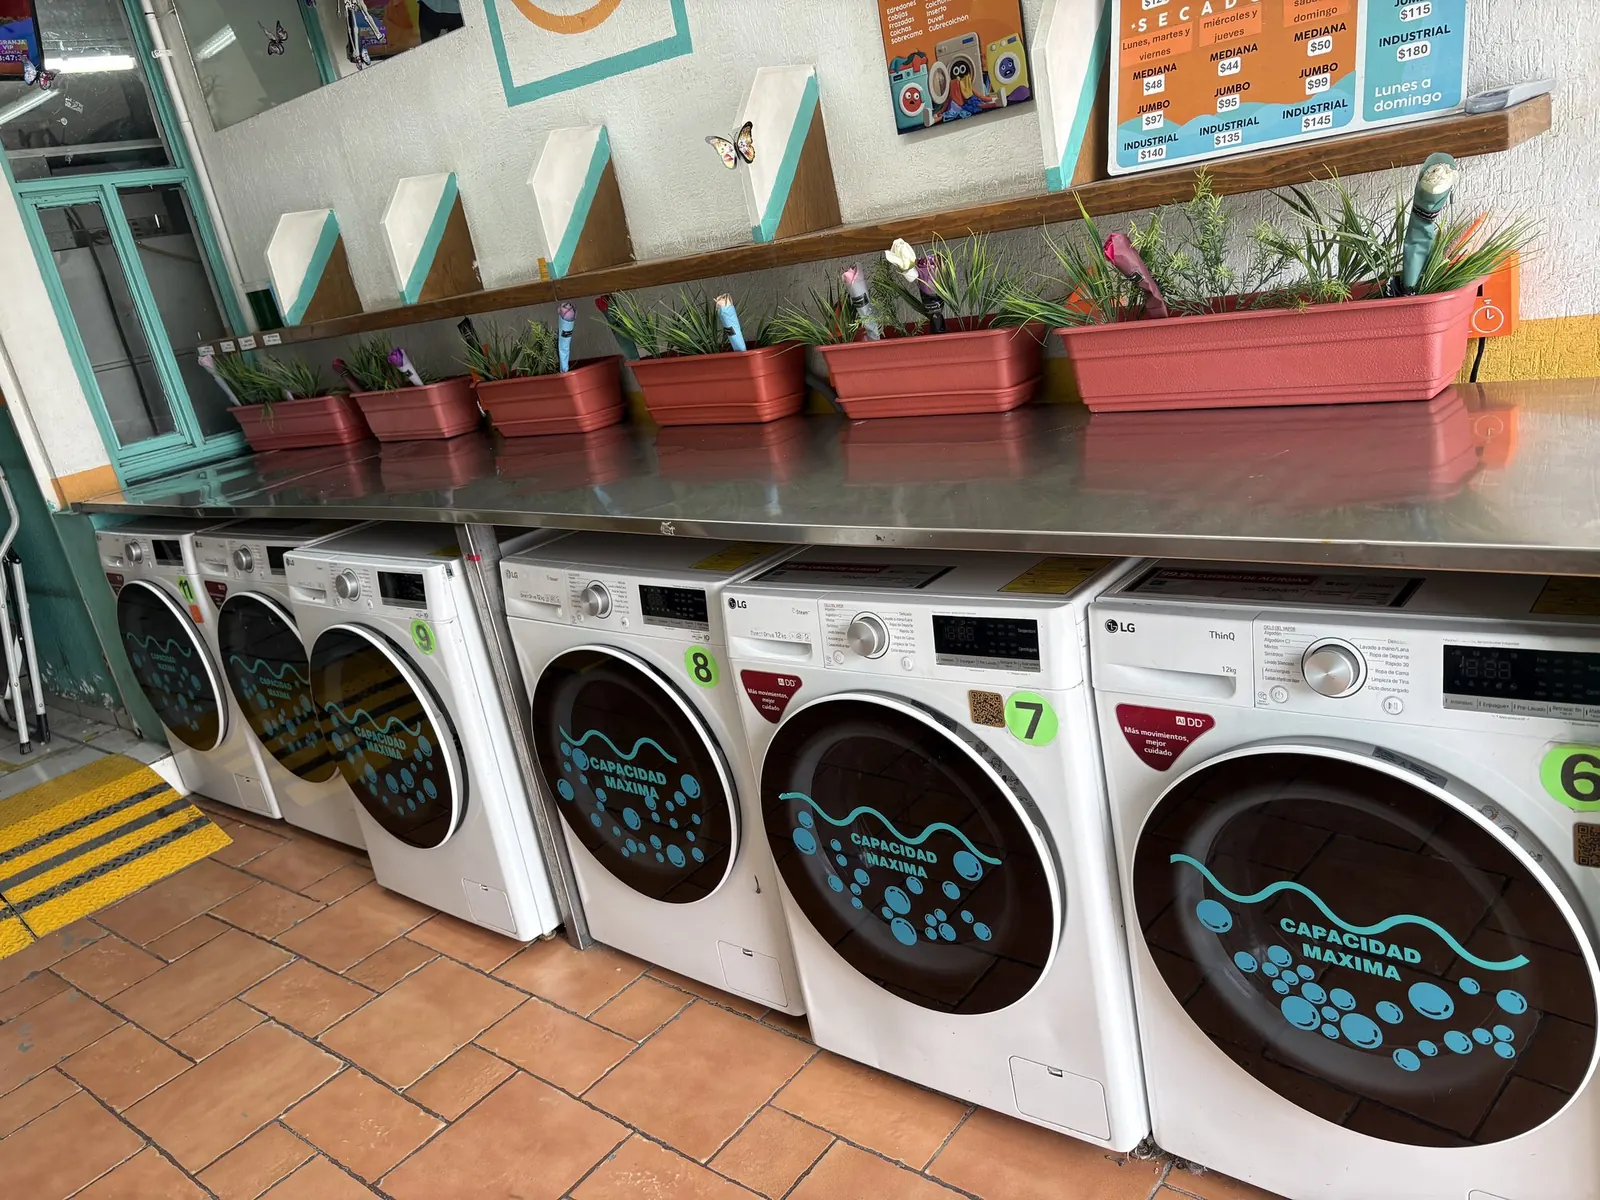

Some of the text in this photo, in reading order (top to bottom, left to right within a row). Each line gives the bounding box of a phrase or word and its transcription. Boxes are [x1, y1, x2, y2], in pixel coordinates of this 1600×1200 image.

[887, 0, 916, 15] Edredones
[1293, 7, 1338, 23] domingo
[1400, 4, 1430, 20] $115
[888, 11, 908, 22] Cobijas
[889, 17, 915, 30] Frazadas
[927, 14, 945, 25] Duvet
[929, 14, 969, 32] Cubrecolchón
[1203, 10, 1258, 29] miércoles y
[890, 25, 912, 37] Colchas
[891, 30, 923, 44] Sobrecama
[1122, 28, 1191, 50] Lunes, martes y
[1214, 28, 1245, 43] jueves
[1294, 22, 1347, 42] MEDIANA
[1379, 24, 1451, 47] INDUSTRIAL
[1139, 48, 1171, 61] viernes
[1210, 43, 1258, 62] MEDIANA
[1310, 40, 1331, 53] $50
[1398, 44, 1428, 60] $180
[1133, 63, 1177, 80] MEDIANA
[1219, 61, 1239, 73] $44
[1299, 62, 1338, 78] JUMBO
[1144, 80, 1163, 91] $48
[1214, 82, 1250, 97] JUMBO
[1307, 77, 1328, 90] $99
[1375, 78, 1431, 97] Lunes a
[1137, 100, 1170, 114] JUMBO
[1218, 98, 1237, 109] $95
[1282, 99, 1348, 119] INDUSTRIAL
[1374, 92, 1442, 112] domingo
[1144, 114, 1163, 126] $97
[1199, 116, 1259, 136] INDUSTRIAL
[1303, 115, 1331, 129] $145
[1124, 133, 1179, 151] INDUSTRIAL
[1215, 132, 1240, 145] $135
[1140, 148, 1164, 160] $140
[1120, 622, 1136, 633] LG
[415, 624, 433, 651] 9
[1209, 631, 1235, 641] ThinQ
[692, 652, 713, 683] 8
[1222, 666, 1237, 675] 12kg
[1015, 701, 1043, 740] 7
[354, 726, 407, 751] CAPACIDAD
[1124, 726, 1190, 743] Más movimientos,
[365, 740, 404, 761] MAXIMA
[1145, 739, 1167, 748] mejor
[1144, 747, 1173, 757] cuidado
[590, 757, 667, 785] CAPACIDAD
[1561, 753, 1600, 802] 6
[604, 775, 660, 800] MAXIMA
[850, 832, 938, 864] CAPACIDAD
[866, 852, 929, 879] MAXIMA
[1280, 917, 1422, 964] CAPACIDAD
[1302, 943, 1402, 982] MAXIMA
